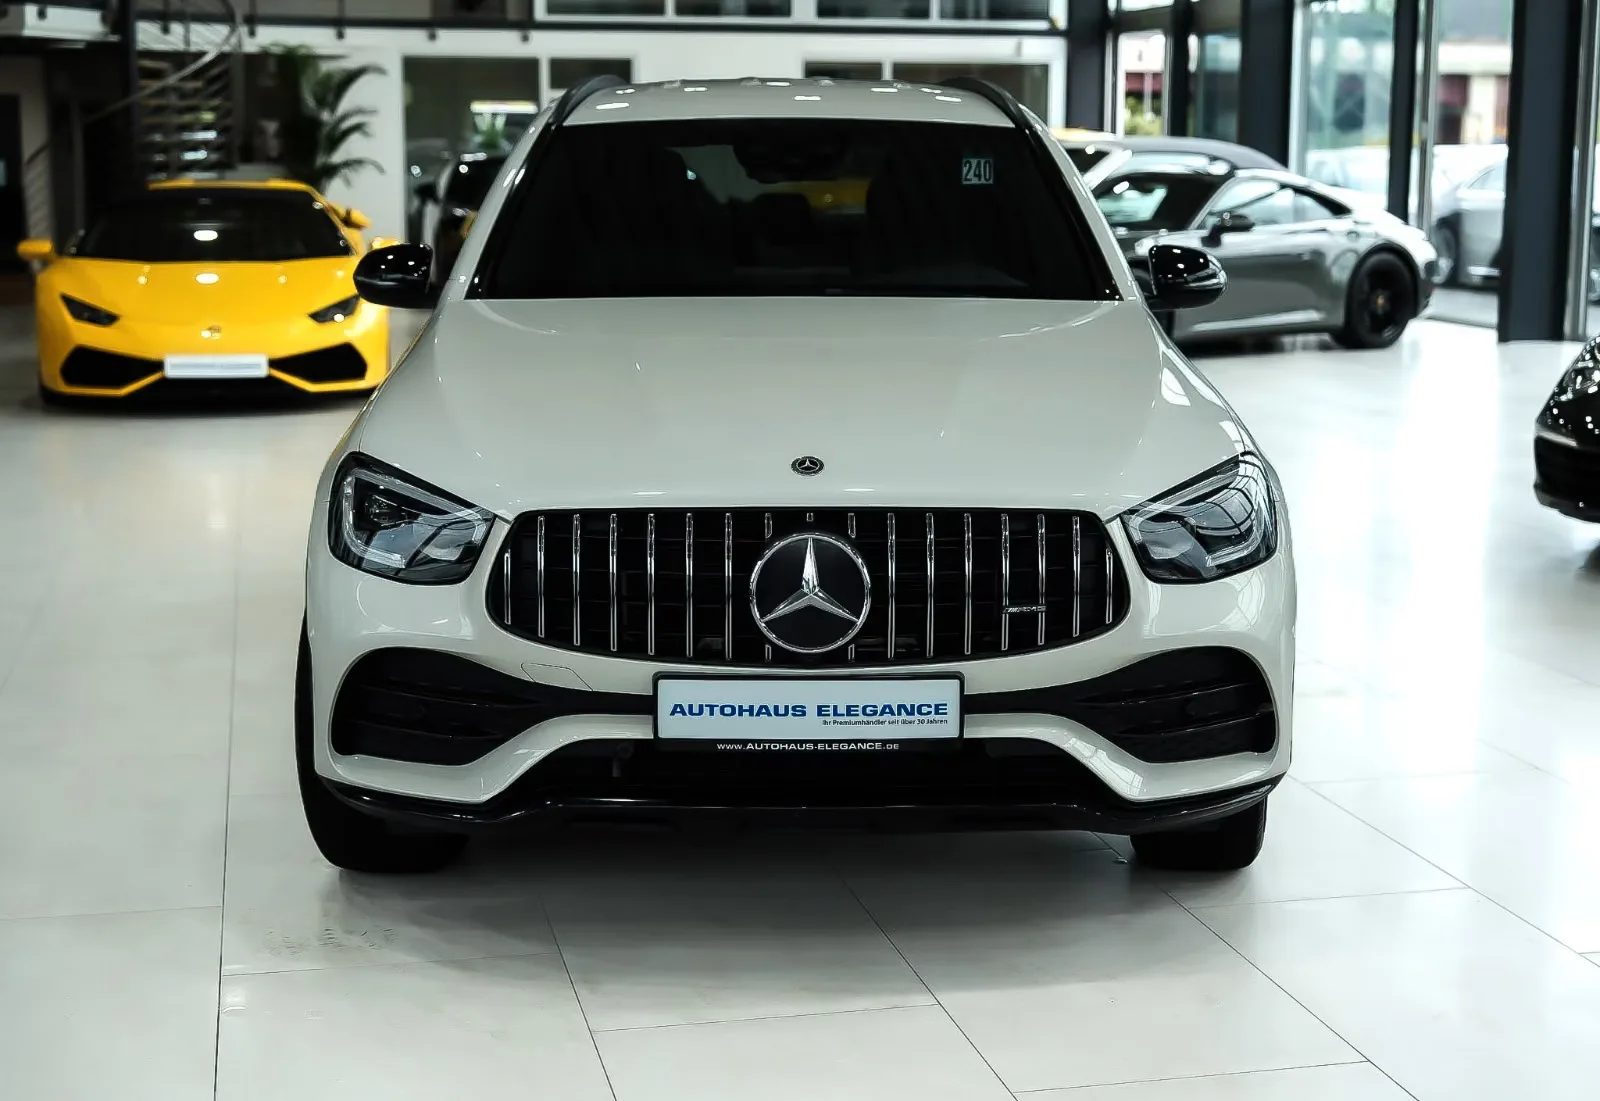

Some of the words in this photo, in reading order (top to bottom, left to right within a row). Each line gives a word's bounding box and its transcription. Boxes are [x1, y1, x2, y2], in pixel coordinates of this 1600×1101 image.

[963, 159, 992, 183] 240
[669, 703, 807, 718] AUTOHAUS
[816, 703, 948, 718] ELEGANCE
[833, 718, 886, 726] Premiumhändler
[926, 717, 948, 725] Jahren
